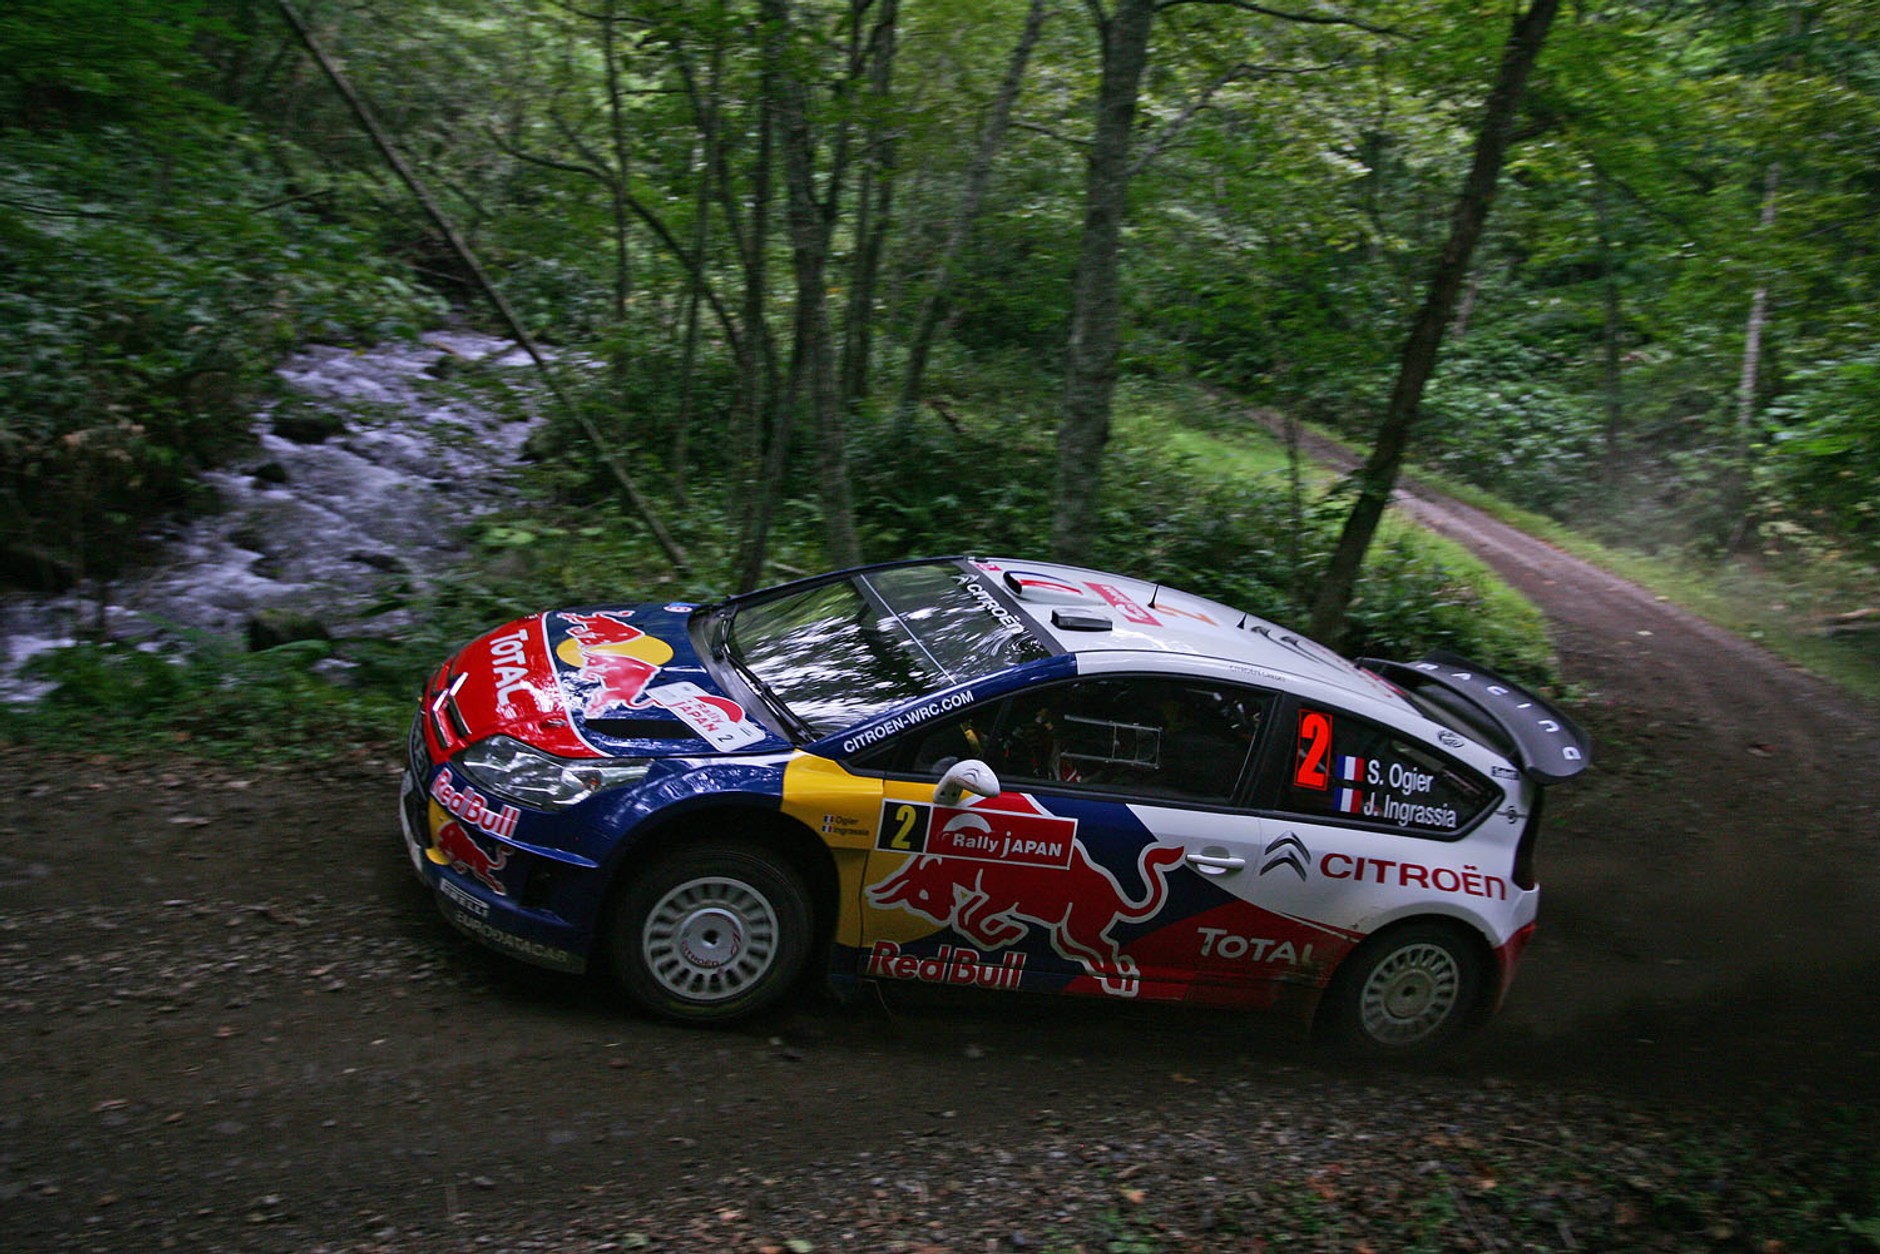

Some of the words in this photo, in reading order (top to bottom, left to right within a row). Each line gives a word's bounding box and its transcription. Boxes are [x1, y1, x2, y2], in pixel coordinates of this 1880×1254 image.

[489, 628, 529, 706] TOTAL
[717, 734, 734, 743] 2
[843, 690, 975, 754] CITROEN-WRC.COM
[1299, 713, 1329, 788] 2
[1367, 757, 1384, 786] S.
[1388, 764, 1434, 796] Ogier
[890, 804, 916, 851] 2
[1363, 795, 1380, 817] J.
[1383, 793, 1457, 829] Ingrassia
[952, 832, 999, 853] Rally
